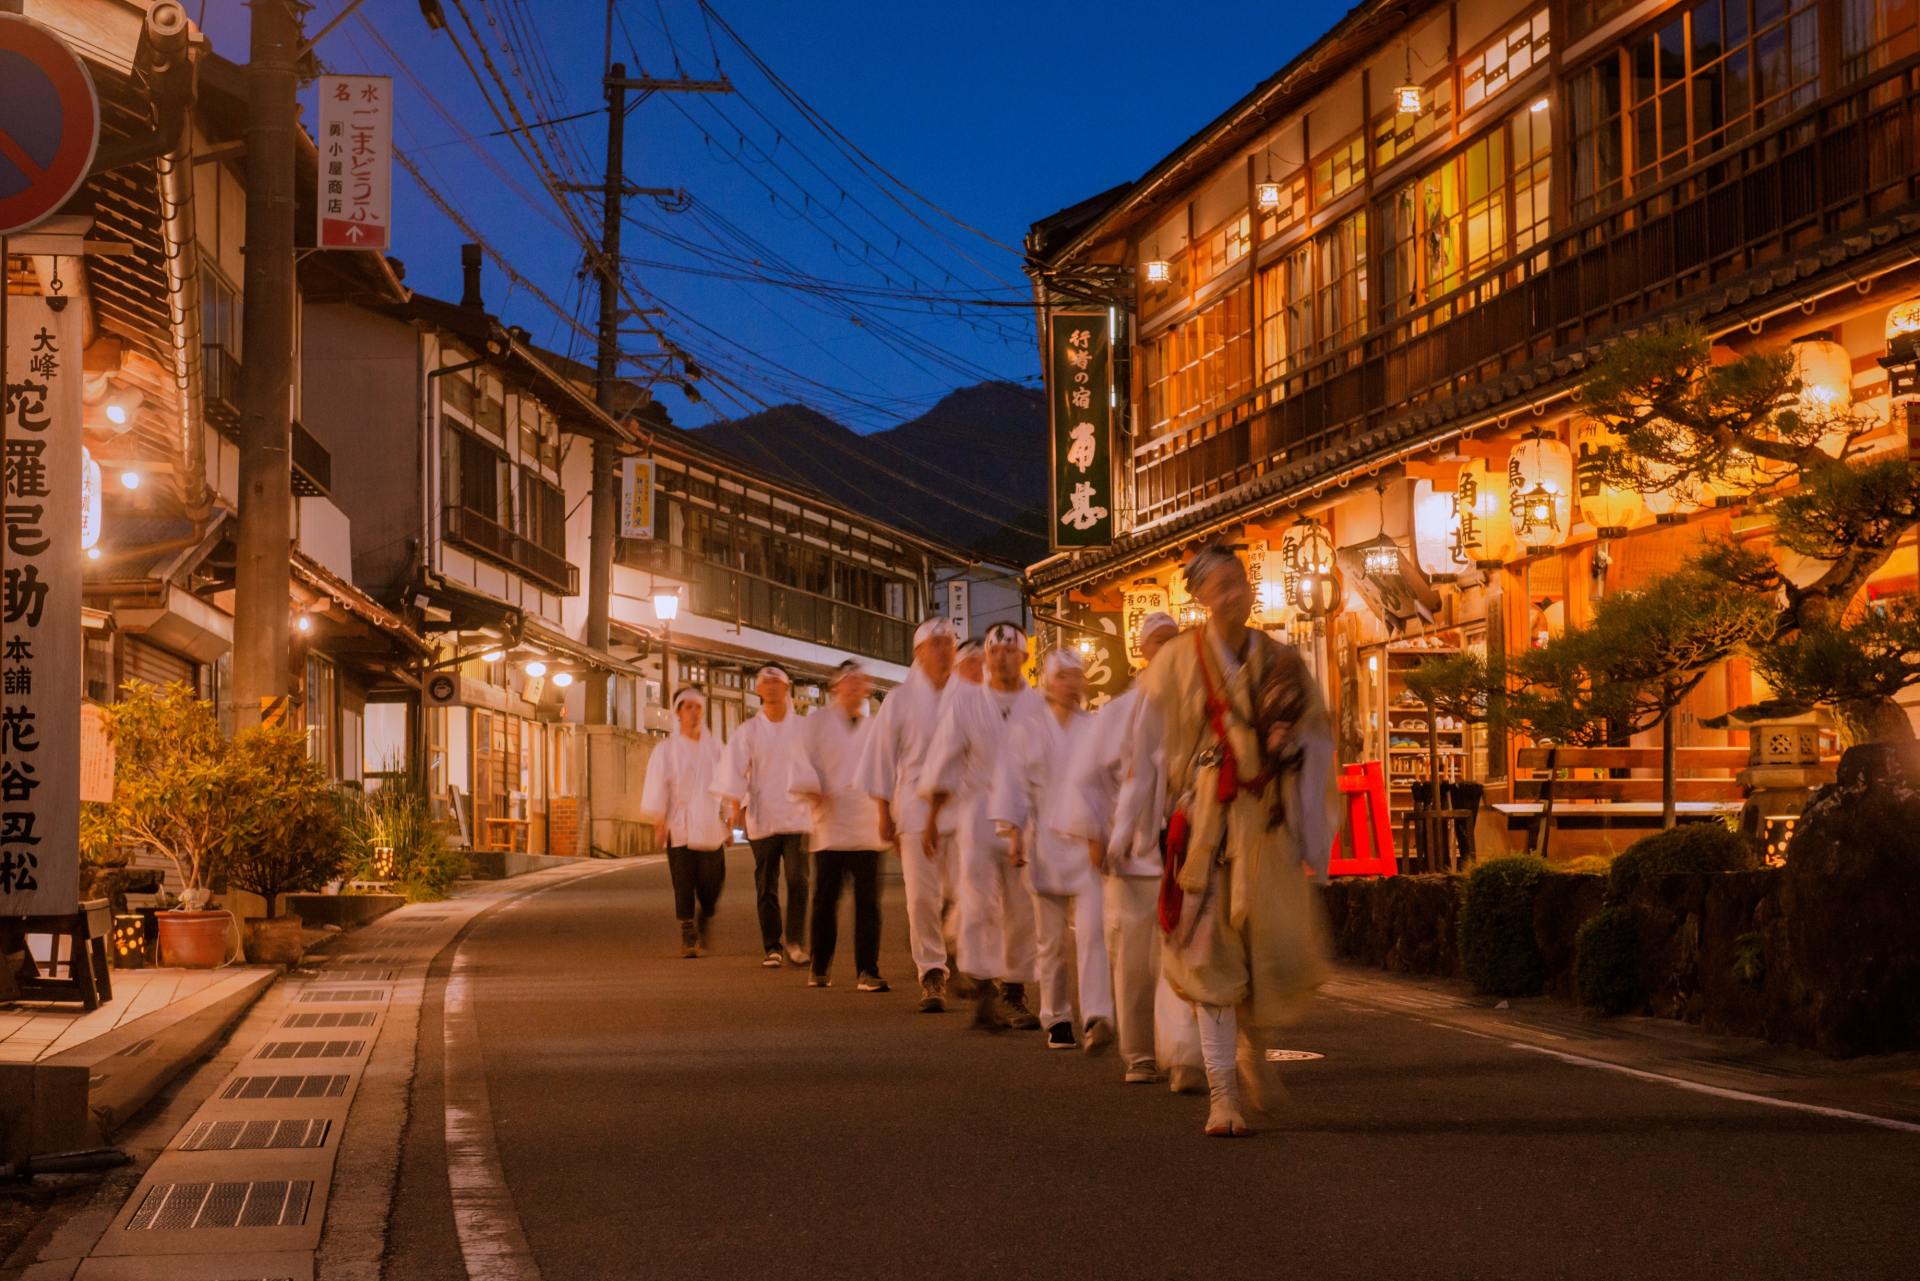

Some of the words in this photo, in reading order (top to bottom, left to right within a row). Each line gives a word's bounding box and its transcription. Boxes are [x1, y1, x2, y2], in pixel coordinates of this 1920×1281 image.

[334, 83, 379, 103] 名水
[350, 108, 379, 221] ごまどうふ
[1069, 329, 1093, 409] 行者の宿
[1060, 422, 1108, 531] 角甚
[1459, 472, 1482, 548] 角甚
